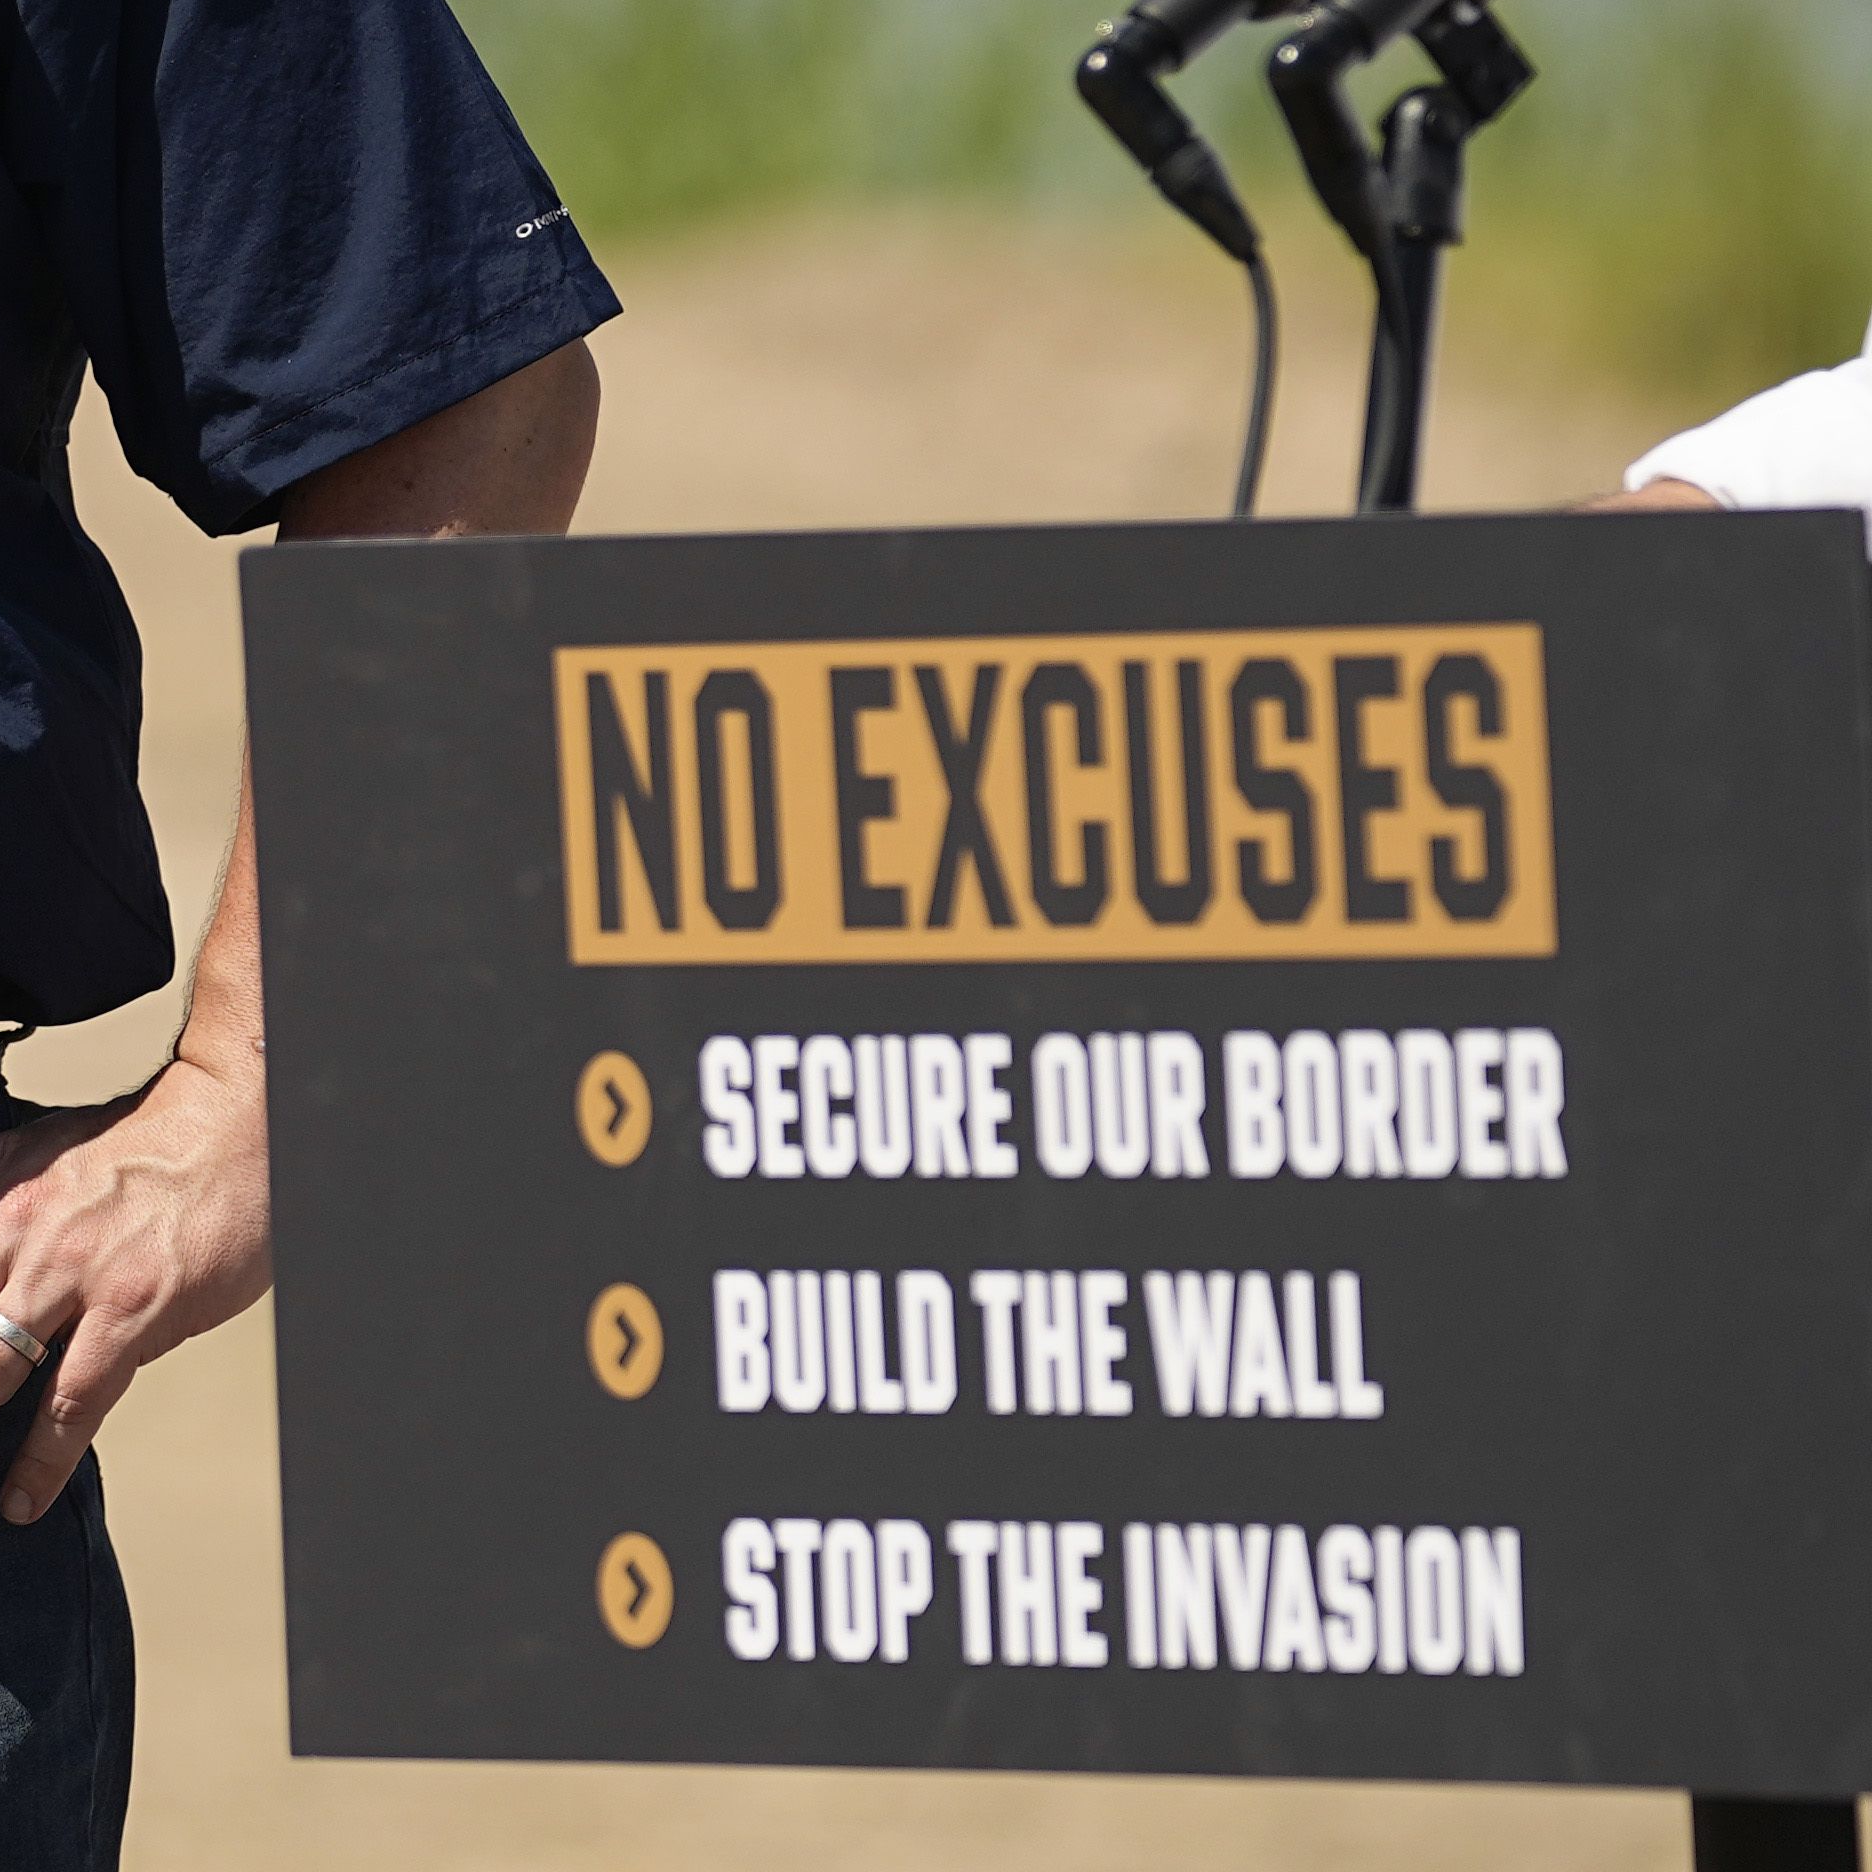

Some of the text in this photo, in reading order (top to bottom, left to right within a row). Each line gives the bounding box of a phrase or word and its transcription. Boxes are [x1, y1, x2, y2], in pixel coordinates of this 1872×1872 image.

[584, 650, 1514, 935] NO EXCUSES
[699, 1028, 1568, 1178] SECURE OUR BORDER
[713, 1269, 1384, 1420] BUILD THE WALL
[722, 1517, 1525, 1676] STOP THE INVASION
